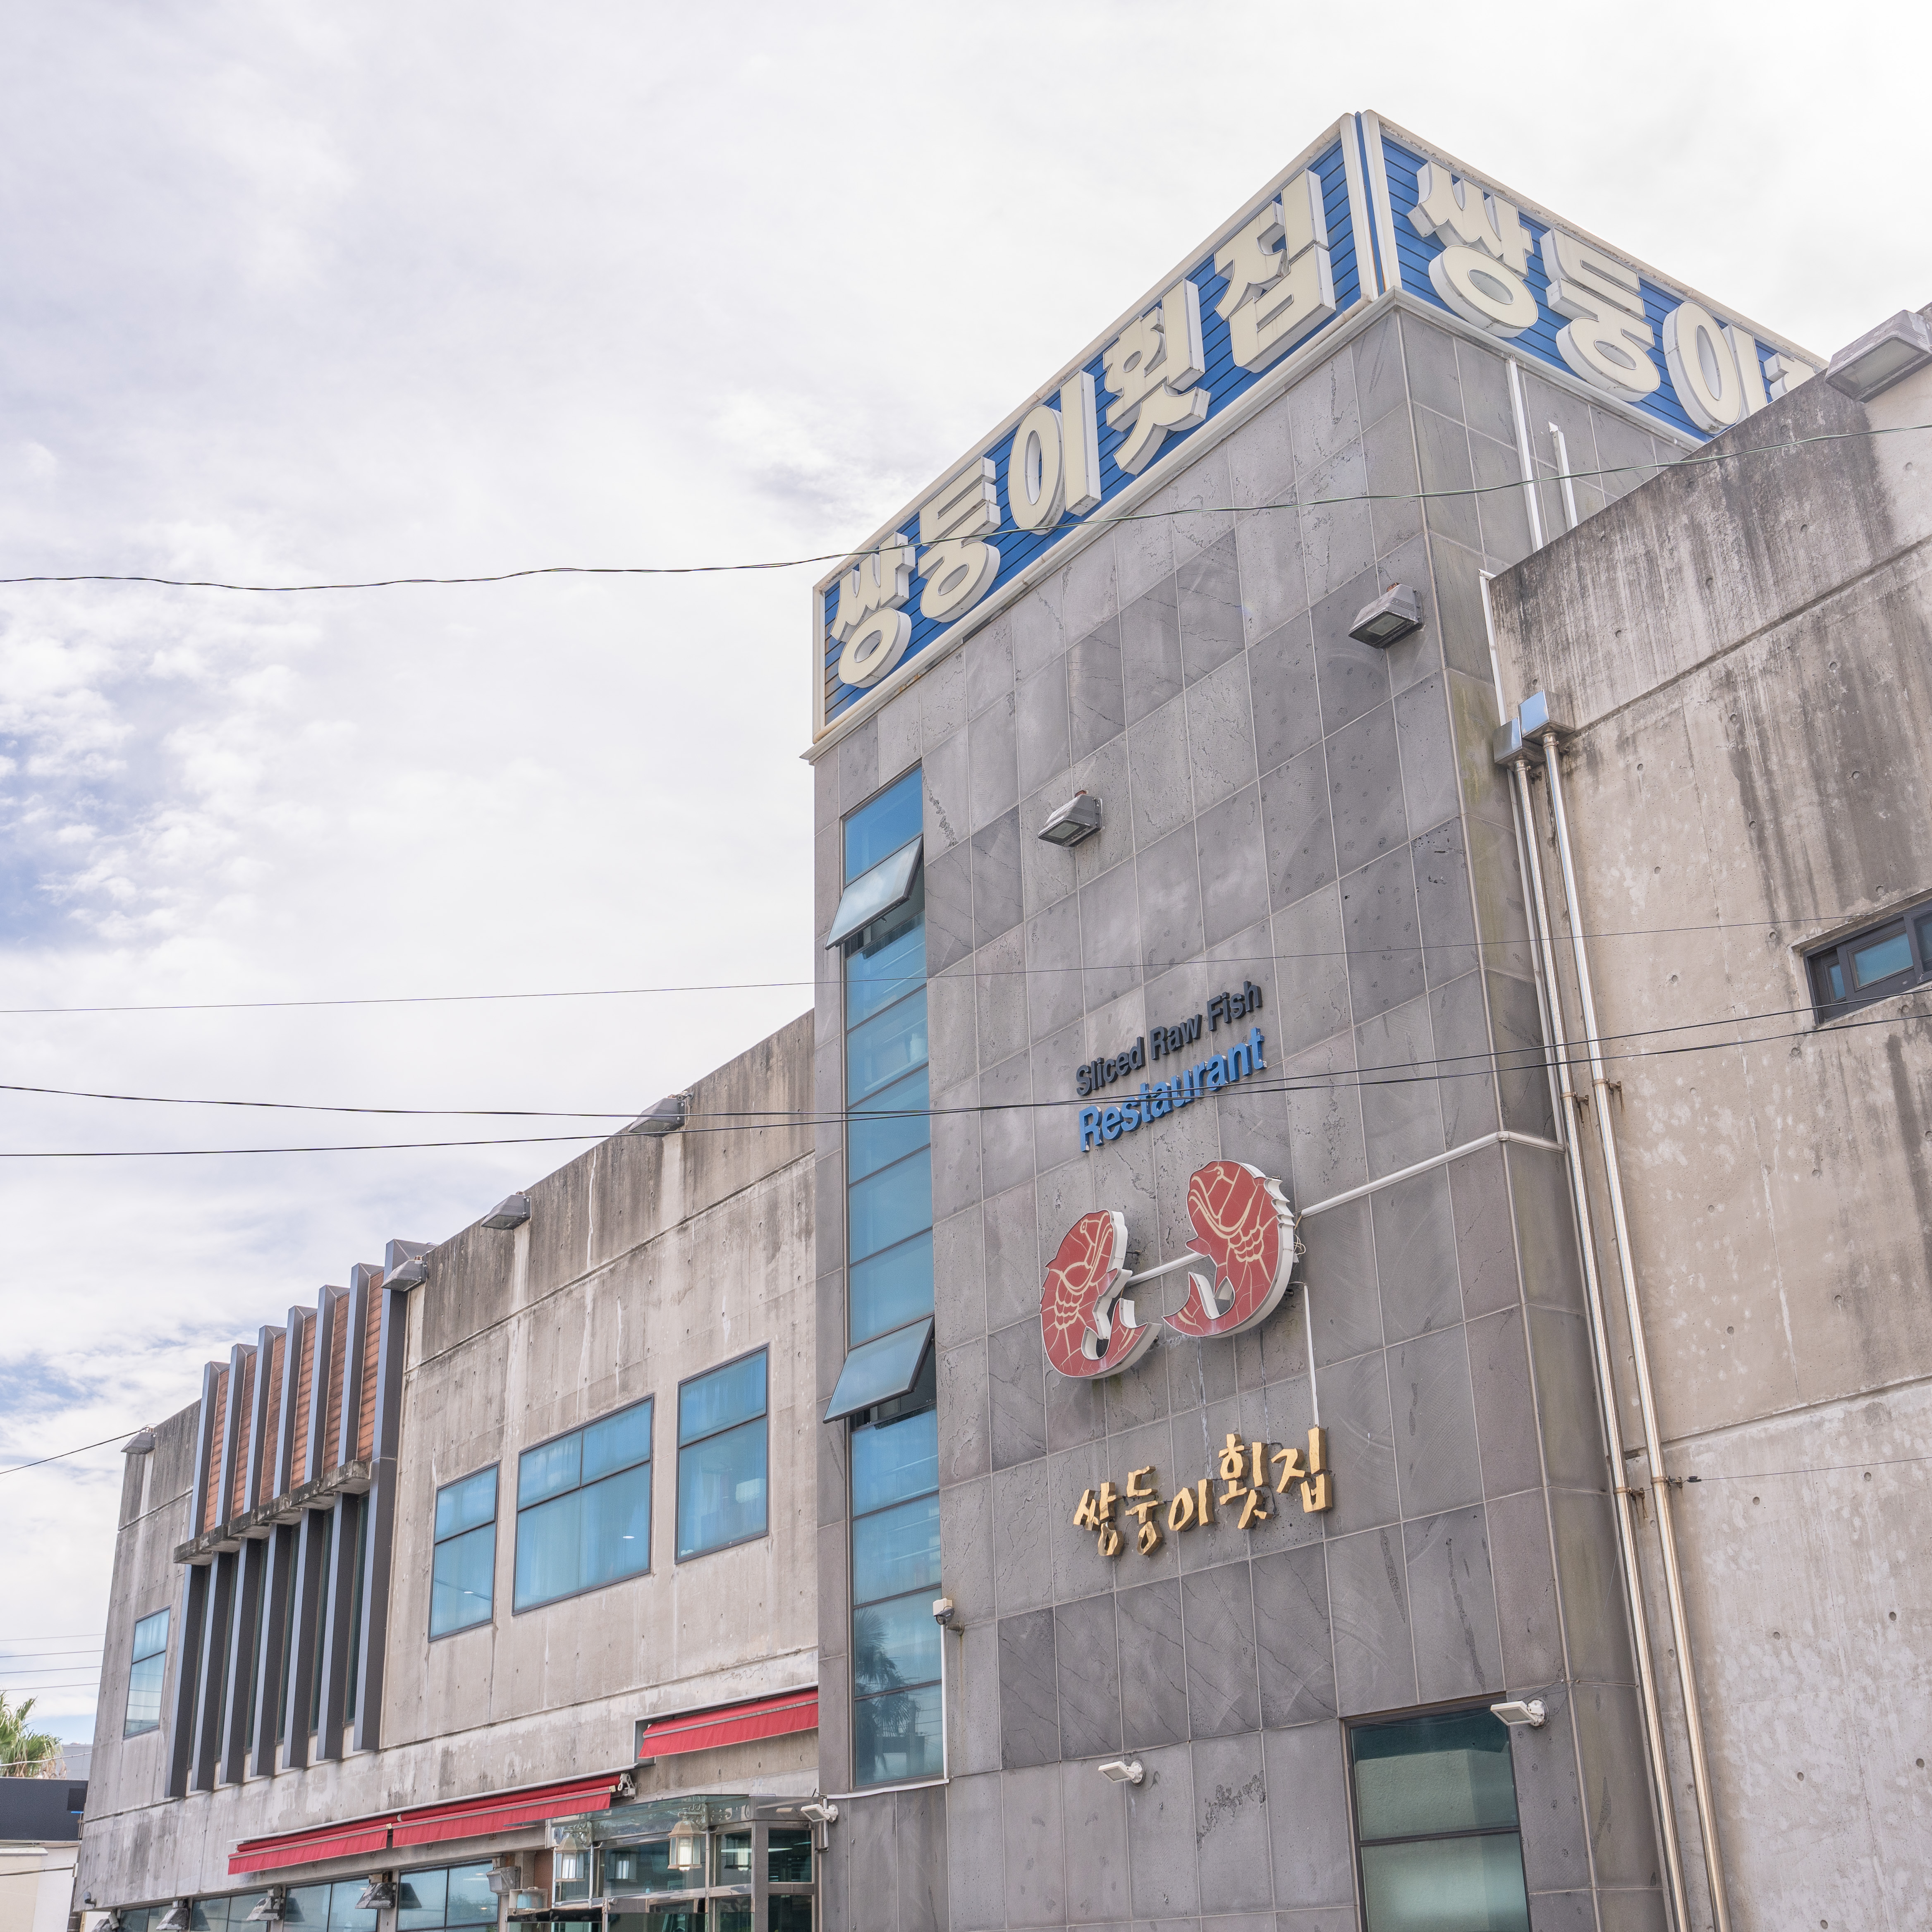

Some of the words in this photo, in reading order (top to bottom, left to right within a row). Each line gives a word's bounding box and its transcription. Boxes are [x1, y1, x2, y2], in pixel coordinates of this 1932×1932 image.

[1407, 160, 1819, 434] 쌍둥이
[830, 169, 1336, 689] 쌍둥이횟집
[1076, 1036, 1145, 1096] Sliced
[1150, 1014, 1203, 1060] Raw
[1207, 980, 1262, 1031] Fish
[1079, 1027, 1267, 1152] Restaurant
[1074, 1427, 1332, 1556] 쌍둥이횟집
